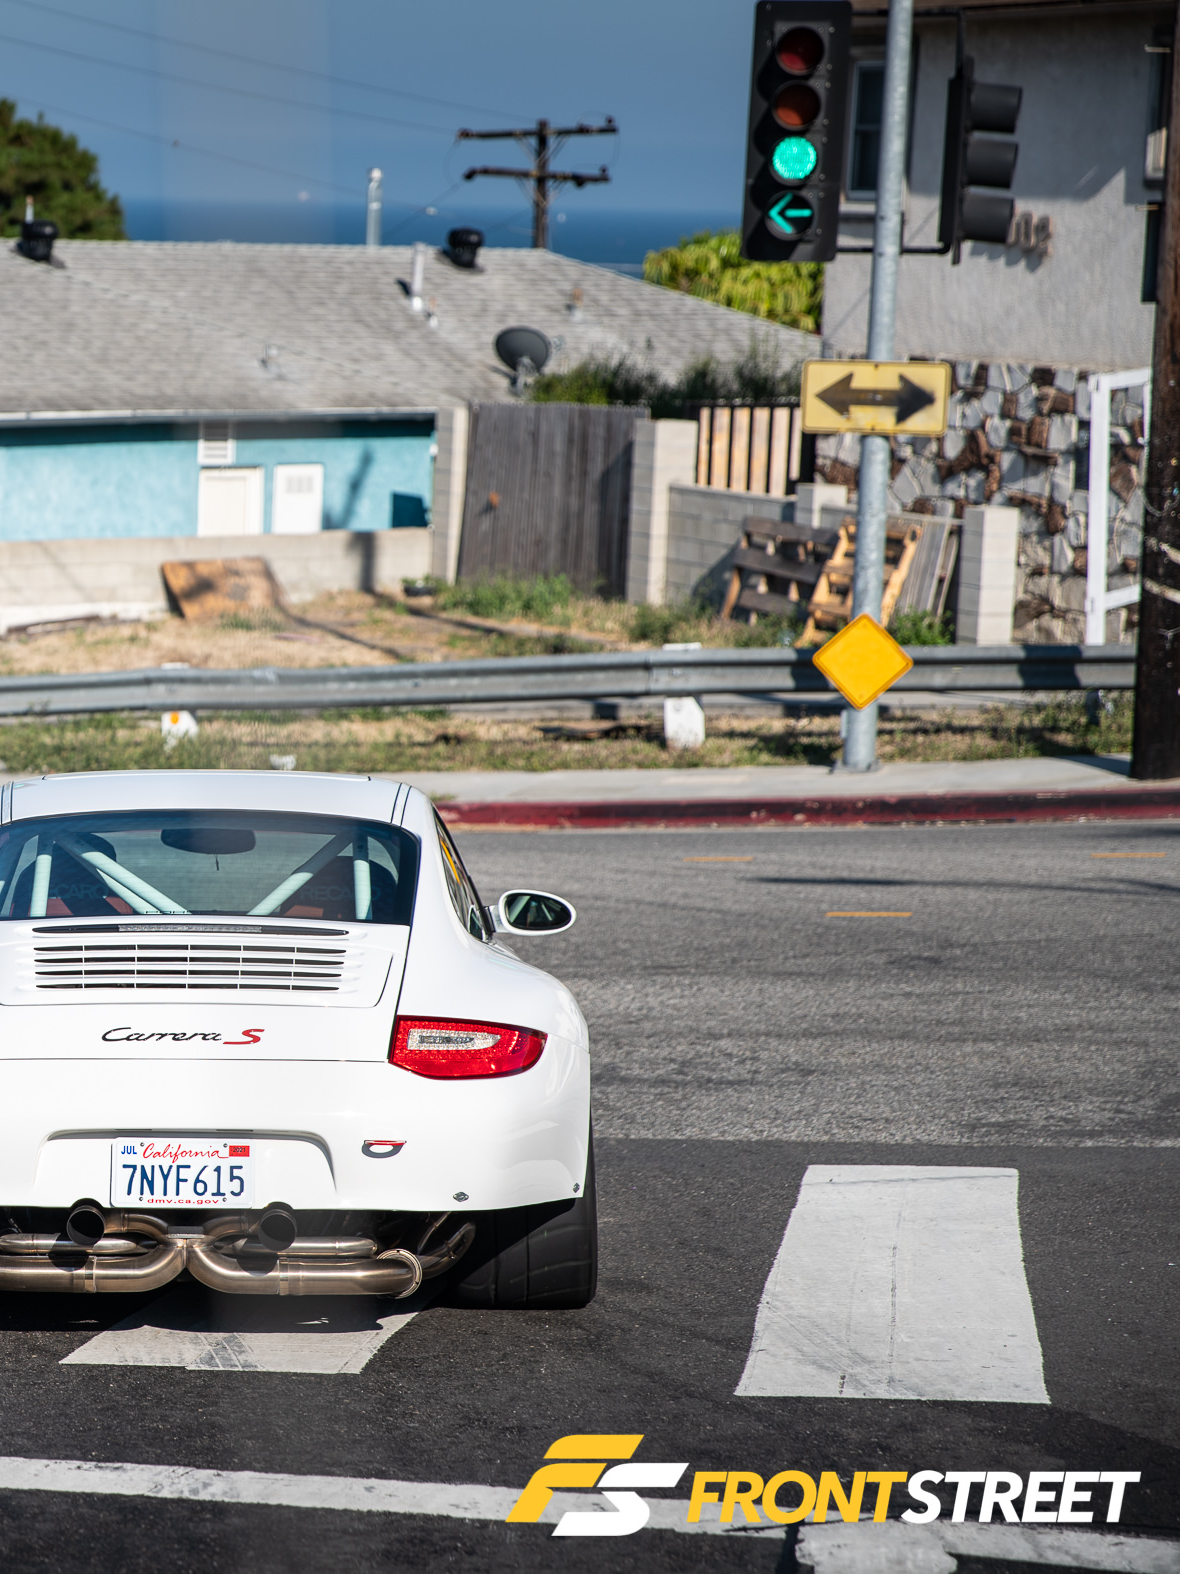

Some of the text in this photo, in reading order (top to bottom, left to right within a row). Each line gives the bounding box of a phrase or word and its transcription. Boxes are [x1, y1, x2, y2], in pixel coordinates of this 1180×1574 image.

[101, 1026, 266, 1045] Carrera S
[120, 1142, 229, 1164] JUL California
[122, 1164, 245, 1197] 7NYF615
